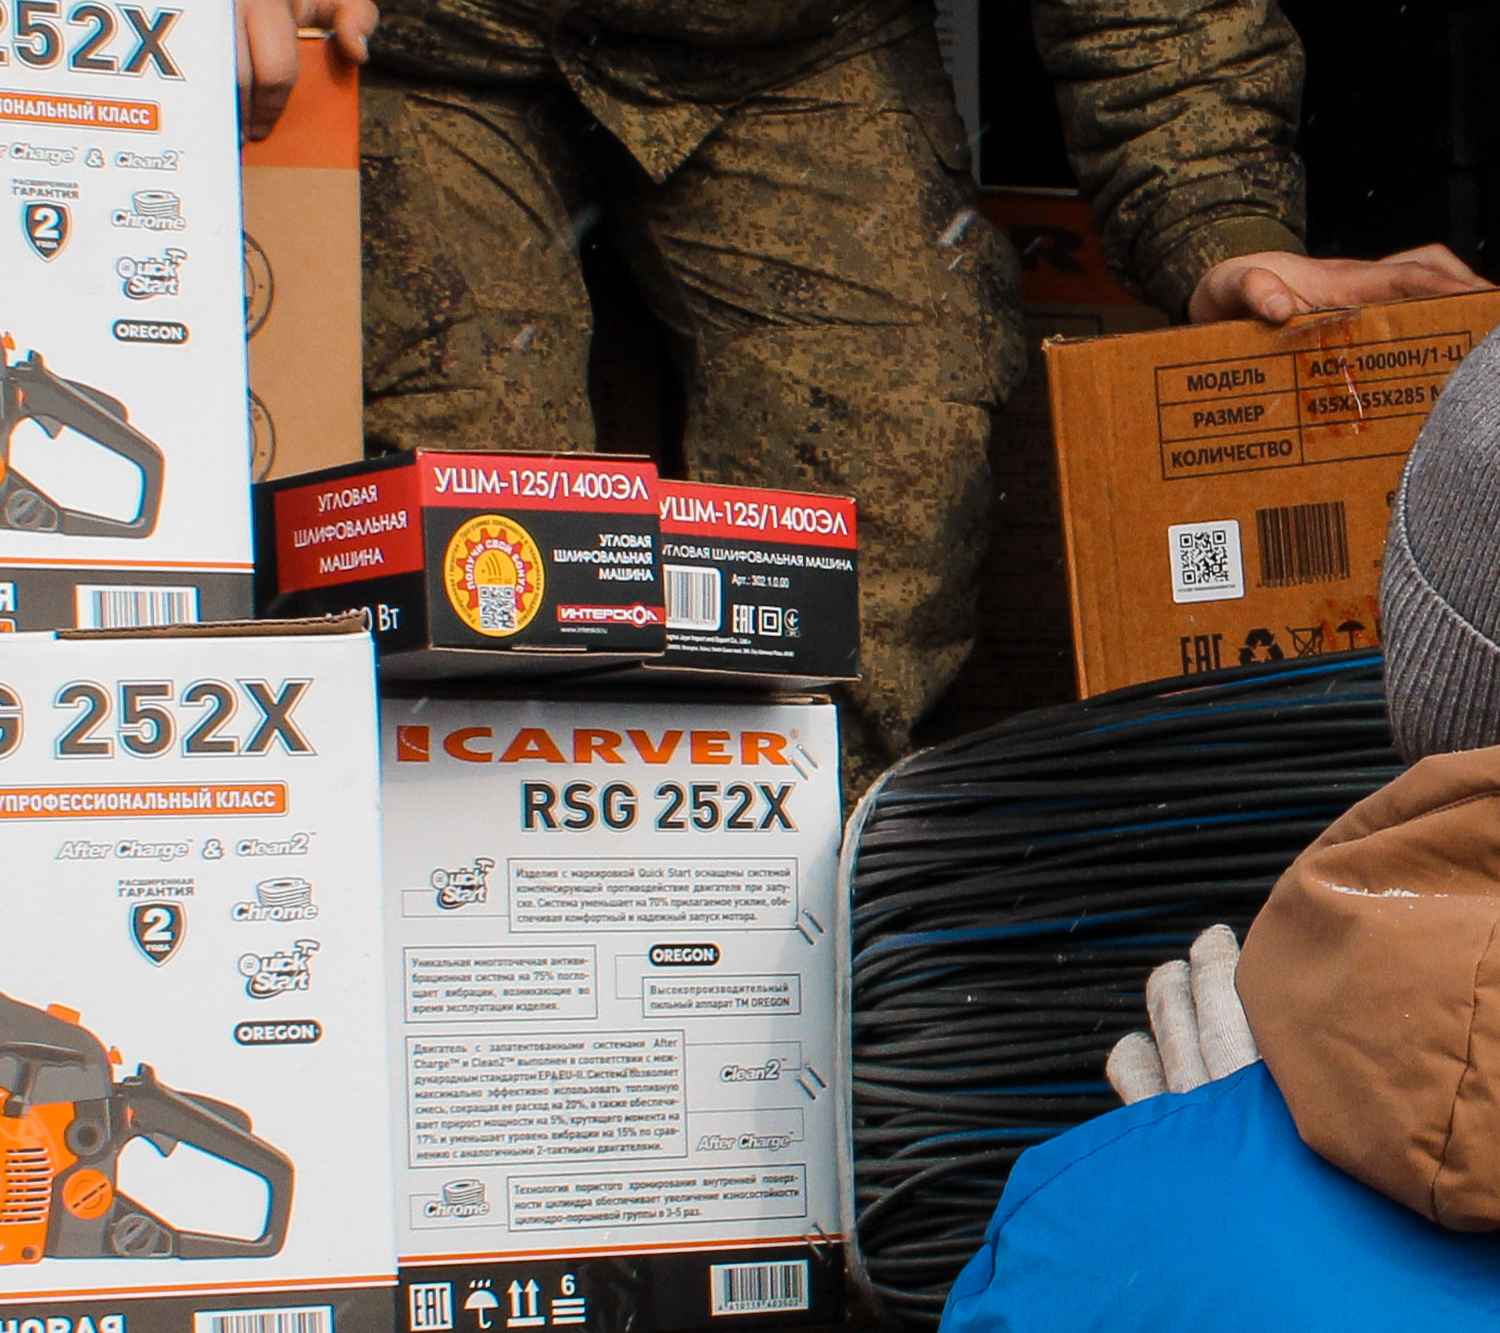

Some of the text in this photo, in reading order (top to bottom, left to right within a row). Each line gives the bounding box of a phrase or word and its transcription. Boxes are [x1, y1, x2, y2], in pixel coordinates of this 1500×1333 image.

[97, 102, 150, 126] КЛАСС
[115, 323, 185, 342] OREGON
[1186, 368, 1266, 392] МОДЕЛЬ
[1193, 405, 1265, 428] РАЗМЕР
[1170, 438, 1293, 469] КОЛИЧЕСТВО
[434, 467, 650, 502] УШМ-125/1400ЭЛ
[318, 484, 378, 512] УГЛОВАЯ
[659, 496, 849, 536] УШМ-125/1400ЭЛ
[293, 510, 408, 548] ШЛИФОВАЛЬНАЯ
[598, 533, 652, 549] УГЛОВАЯ
[319, 549, 384, 574] МАШИНА
[554, 550, 654, 566] ШЛИФОВАЛЬНАЯ
[713, 548, 804, 567] ШЛИФОВАЛЬНАЯ
[805, 555, 853, 572] МАШИНА
[598, 568, 654, 582] МАШИНА
[377, 605, 400, 630] Вт
[560, 606, 658, 625] ИНТЕРСКОЛ
[54, 677, 319, 759] 252X
[443, 726, 791, 766] CARVER
[216, 789, 276, 809] КЛАСС
[521, 779, 799, 833] RSG 252X
[55, 839, 113, 860] After
[201, 838, 225, 859] &
[118, 887, 195, 897] ГАРАНТИЯ
[142, 907, 174, 941] 2
[231, 903, 319, 922] Chrome
[651, 947, 716, 964] OREGON
[650, 983, 789, 997] Высокопроизводительный
[750, 997, 790, 1008] OREGON
[238, 1024, 315, 1042] OREGON
[720, 1058, 781, 1082] Clean2
